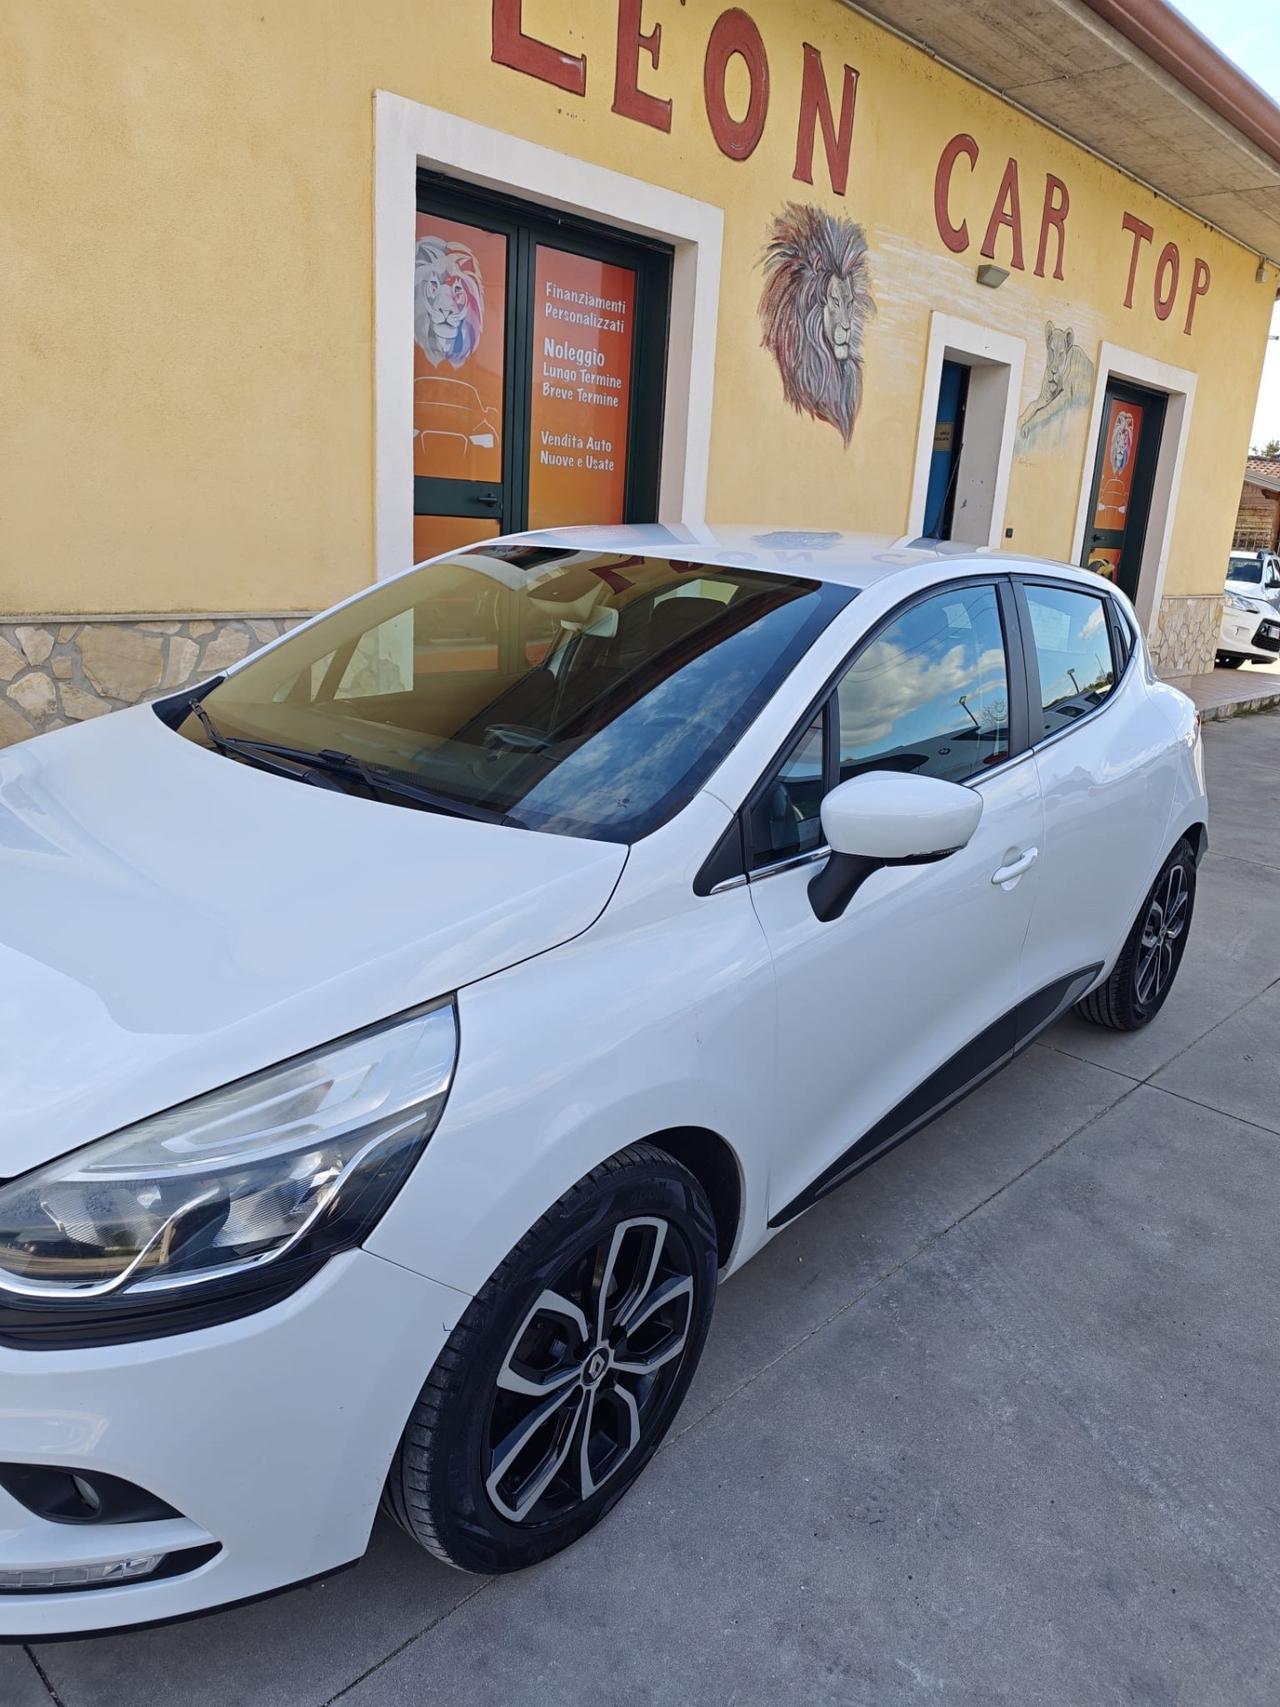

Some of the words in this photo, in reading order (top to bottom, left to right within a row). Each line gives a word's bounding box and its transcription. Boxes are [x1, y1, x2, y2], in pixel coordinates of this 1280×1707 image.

[934, 133, 1070, 281] CAR
[1122, 211, 1211, 335] TOP
[545, 281, 626, 315] Finanziamenti
[544, 302, 625, 334] Personalizzati
[543, 337, 605, 367] Noleggio
[543, 362, 577, 382] Lungo
[580, 369, 622, 389] Termine
[542, 382, 574, 400] Breve
[577, 388, 619, 408] Termine
[541, 431, 583, 449] Vendita
[586, 436, 612, 453] Auto
[540, 450, 574, 467] Nuove
[577, 457, 583, 468] e
[585, 455, 615, 471] Usate
